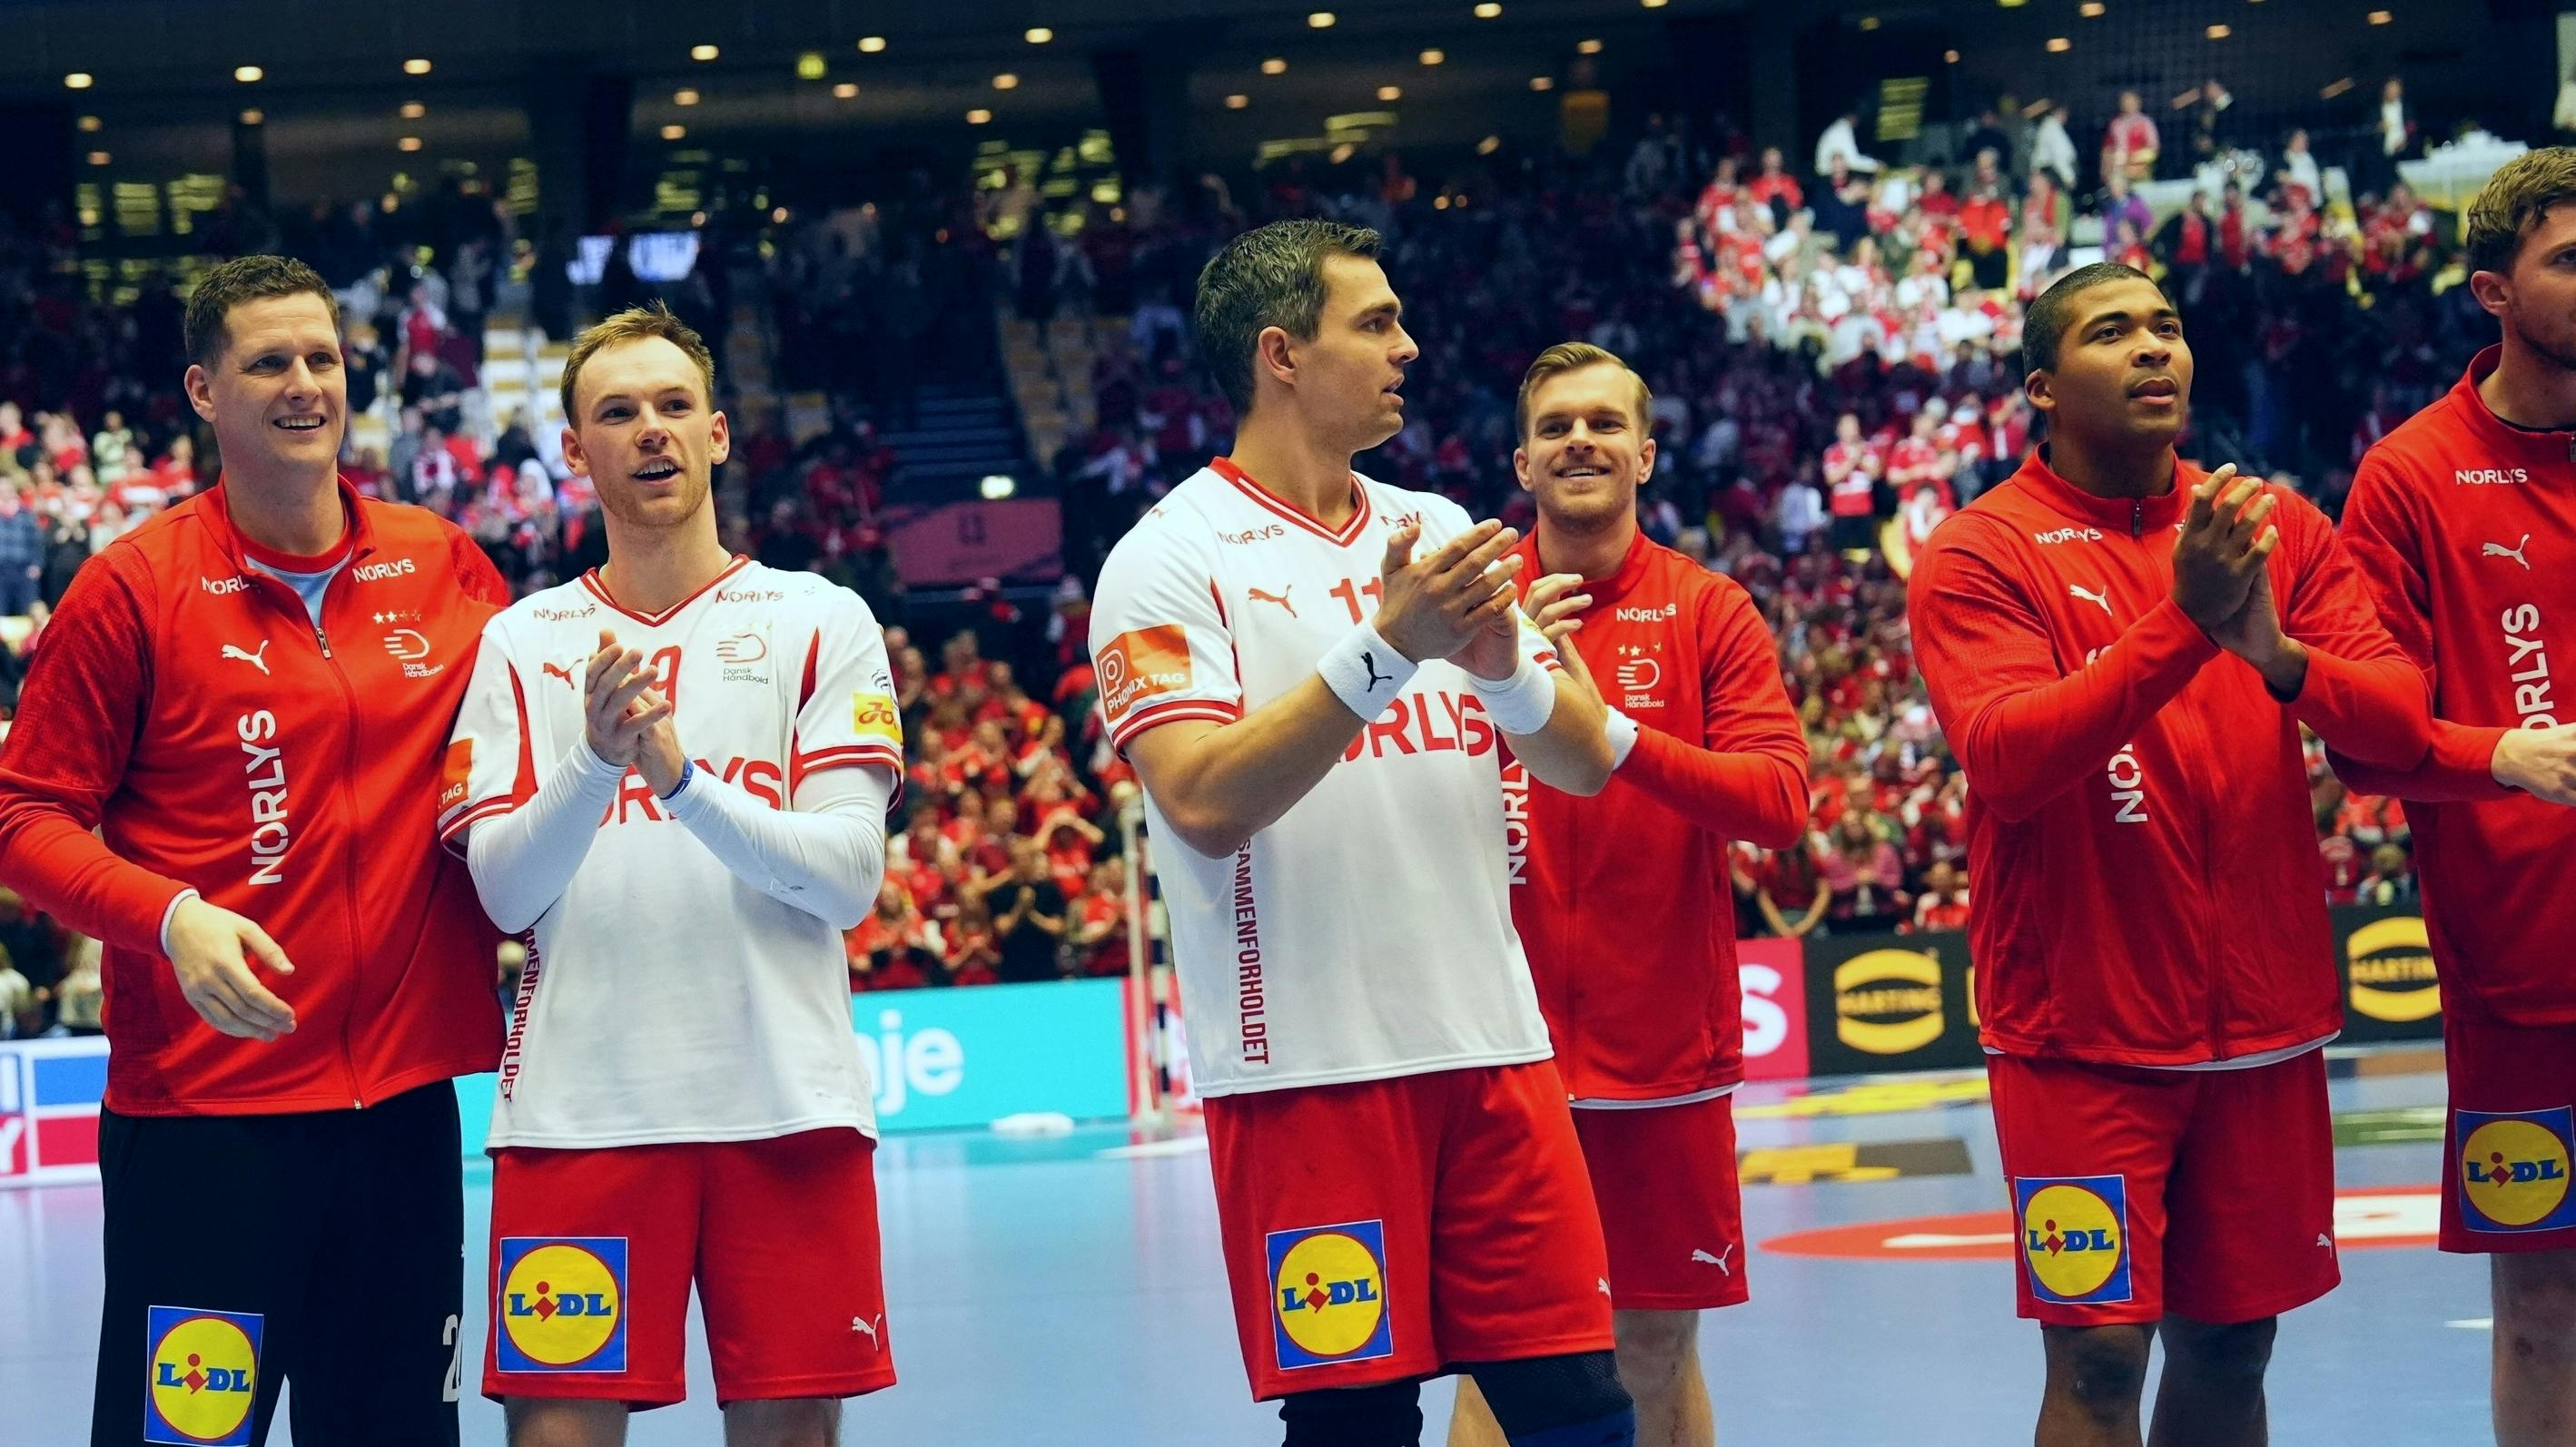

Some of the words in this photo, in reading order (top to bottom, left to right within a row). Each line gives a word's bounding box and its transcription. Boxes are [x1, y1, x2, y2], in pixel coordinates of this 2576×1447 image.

[2454, 468, 2529, 485] NORLYS
[1217, 524, 1285, 546] NORLYS
[2033, 527, 2104, 546] NORYS
[352, 558, 416, 583] NORLYS
[201, 575, 251, 596] NORL
[1615, 602, 1677, 624] NORLYS
[402, 662, 427, 672] Dansk
[723, 667, 753, 675] Dansk
[1149, 672, 1186, 687] TAG
[1624, 693, 1651, 702] Dansk
[1624, 699, 1665, 709] Håndbold
[1337, 690, 1495, 763] RLYS
[237, 709, 289, 886] NORLYS
[440, 783, 464, 806] TAG
[1500, 758, 1529, 886] NORL
[1234, 836, 1269, 1065] SAMMENFORHOLDET
[442, 1314, 464, 1403] 2
